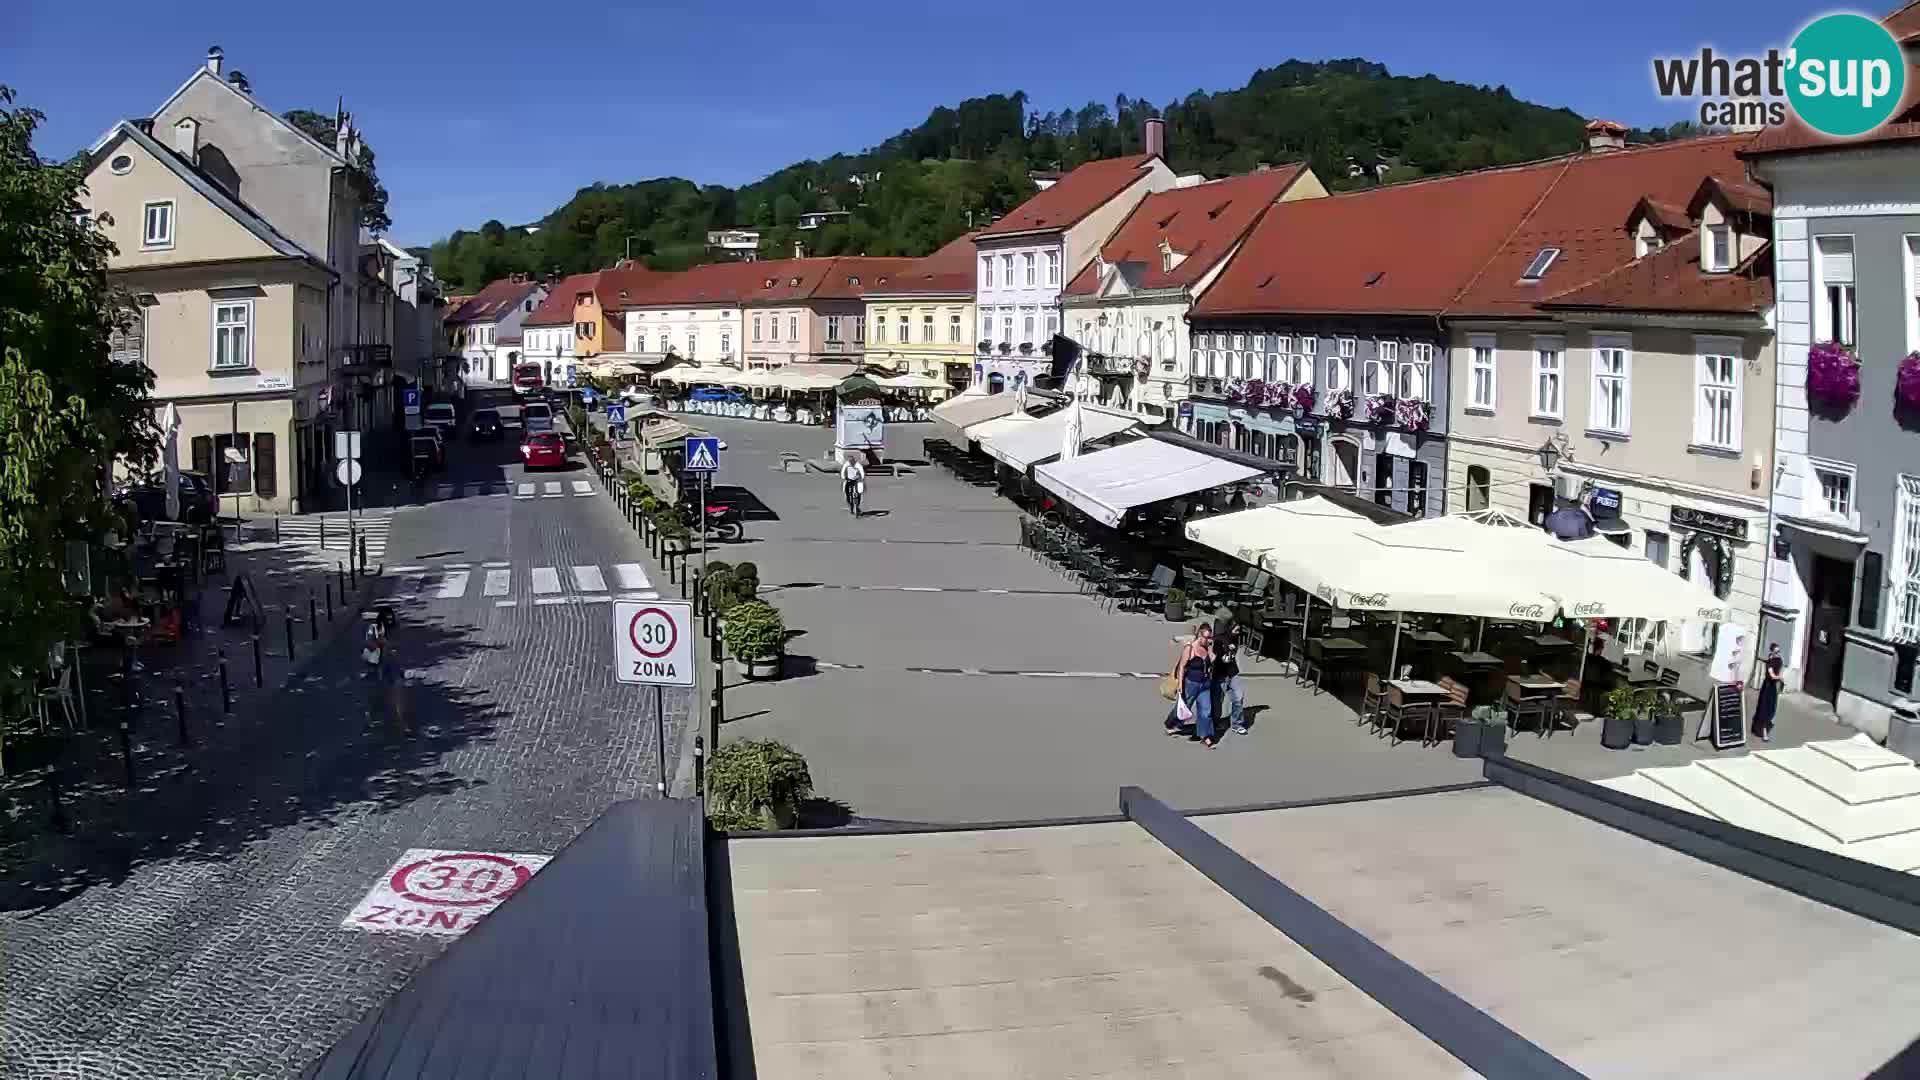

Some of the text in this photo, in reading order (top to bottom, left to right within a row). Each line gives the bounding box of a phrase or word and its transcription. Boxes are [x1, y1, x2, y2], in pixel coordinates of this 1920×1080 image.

[408, 392, 416, 404] P
[642, 623, 666, 645] 30
[632, 660, 677, 678] ZONA
[418, 866, 503, 893] 30
